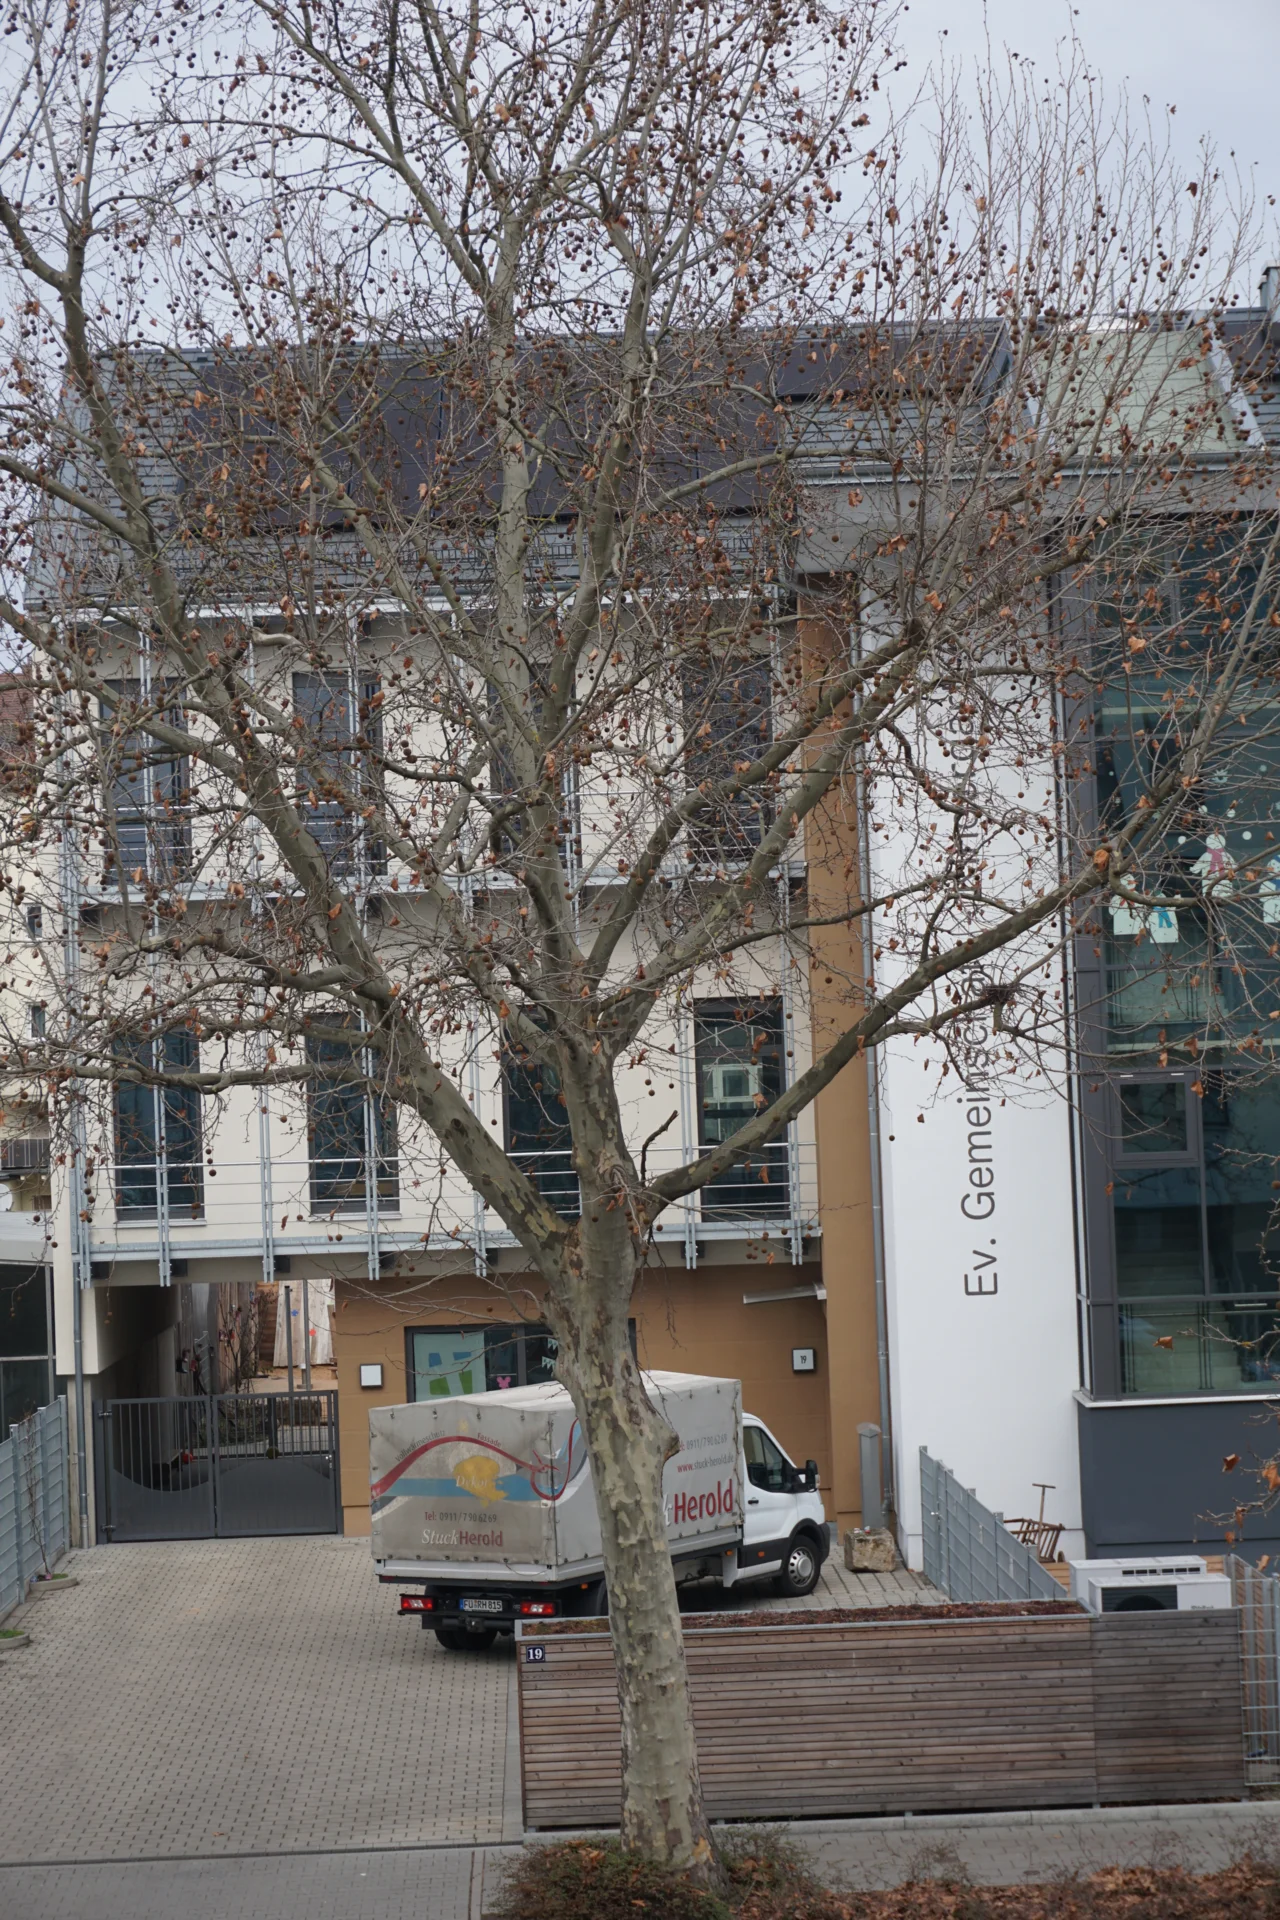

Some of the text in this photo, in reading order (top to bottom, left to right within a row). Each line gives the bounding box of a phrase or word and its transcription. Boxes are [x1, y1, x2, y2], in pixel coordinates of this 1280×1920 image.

[964, 1238, 998, 1297] Ev.
[477, 1432, 502, 1448] Fassade
[677, 1452, 734, 1473] www.stuck-herold.de
[425, 1511, 437, 1521] Tel:
[528, 1648, 543, 1660] 19
